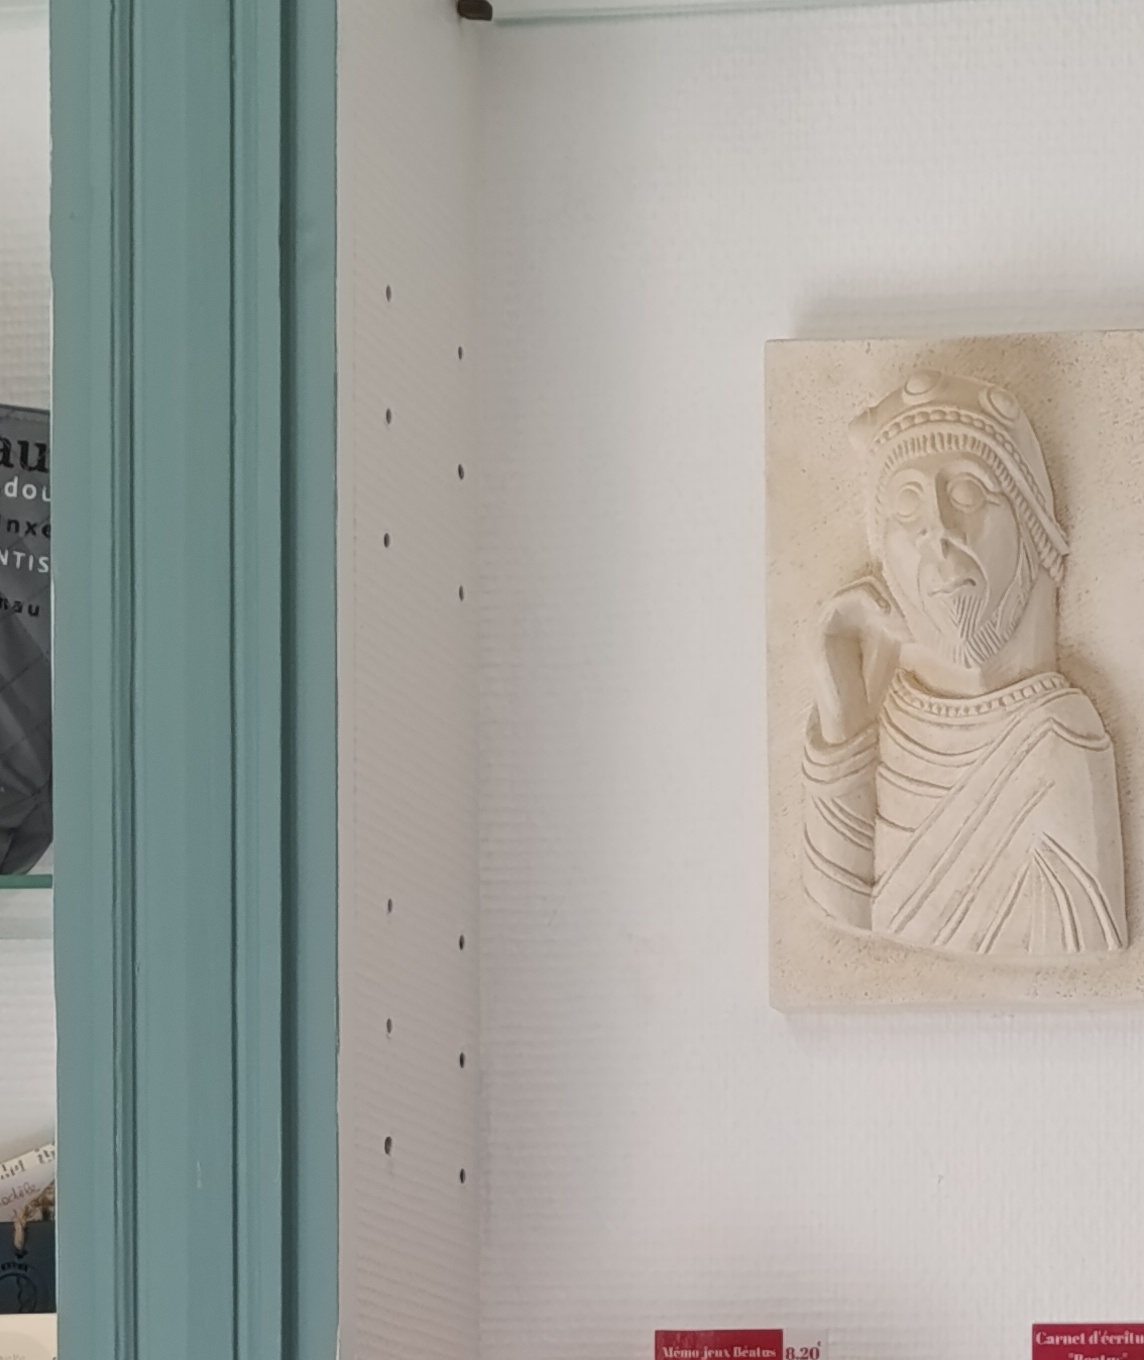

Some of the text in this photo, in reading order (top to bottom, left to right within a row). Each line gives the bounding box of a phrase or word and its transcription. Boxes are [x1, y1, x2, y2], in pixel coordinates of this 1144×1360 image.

[1035, 1331, 1086, 1345] Carnet
[662, 1346, 699, 1358] Mémo
[701, 1346, 730, 1360] jeux
